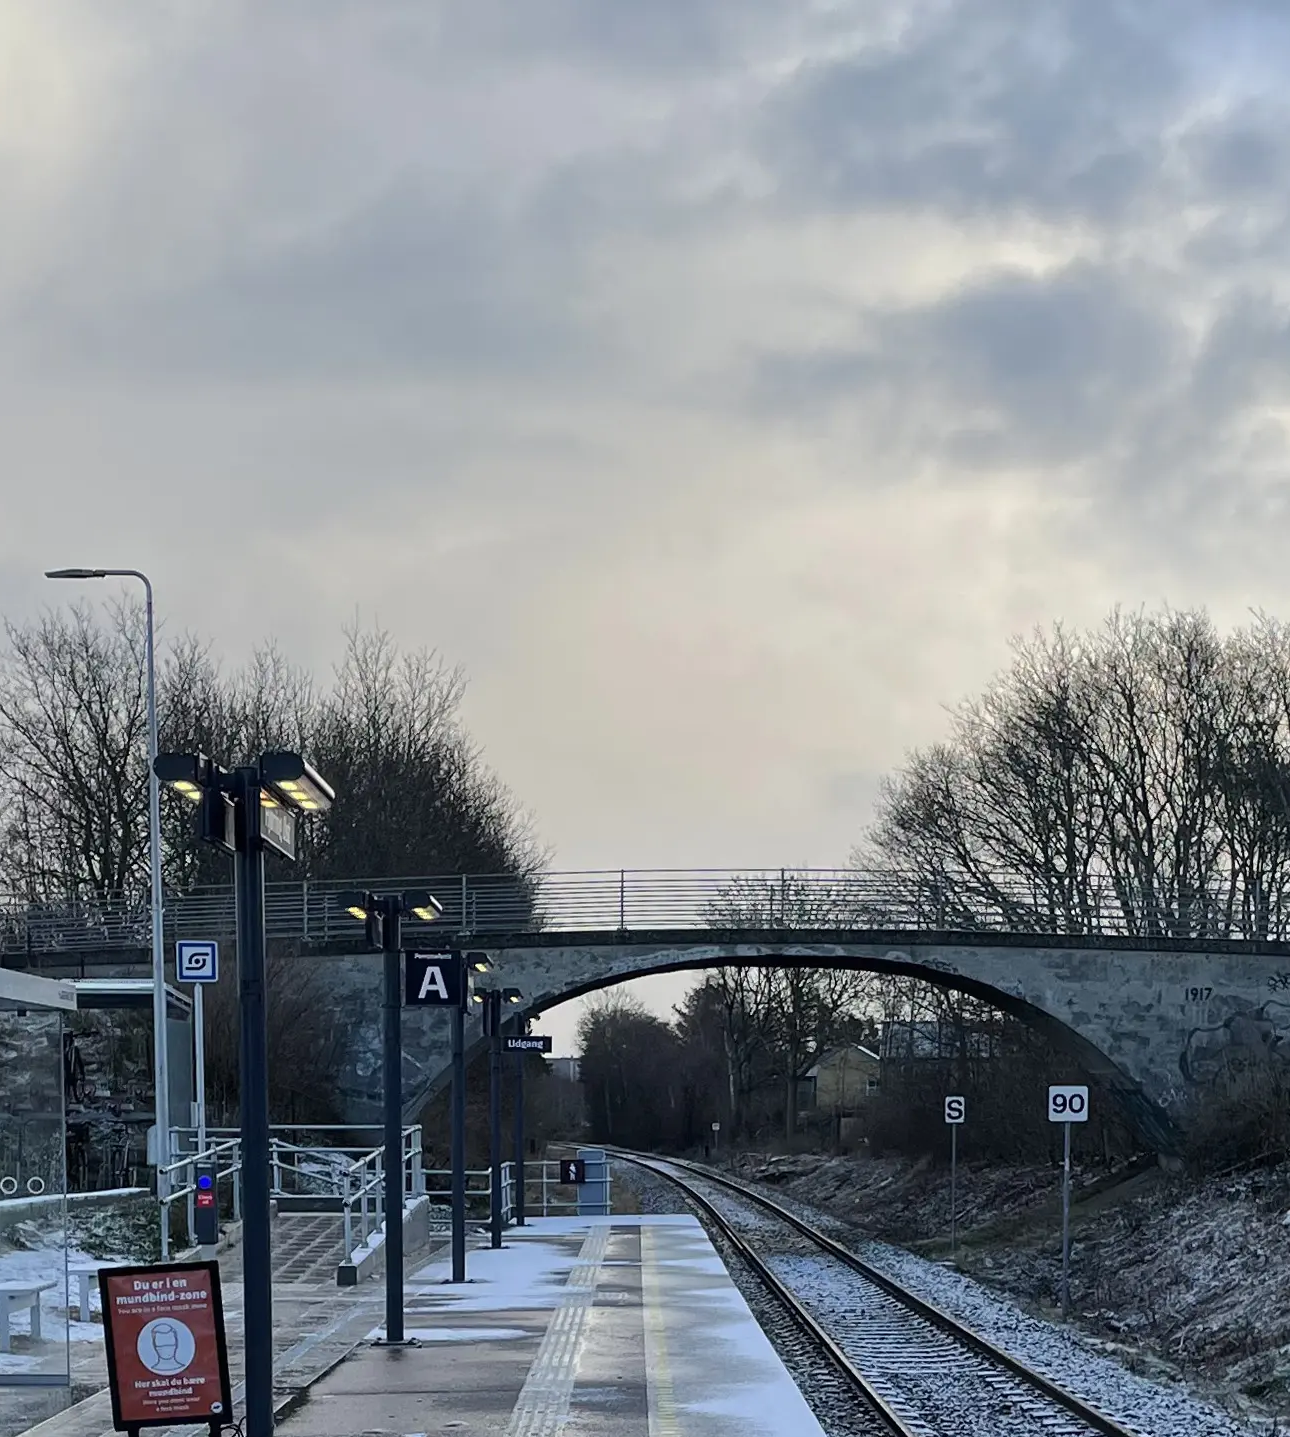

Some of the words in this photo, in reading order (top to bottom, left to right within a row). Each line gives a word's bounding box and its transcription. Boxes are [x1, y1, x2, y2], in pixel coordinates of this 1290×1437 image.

[418, 966, 449, 999] A
[1185, 987, 1213, 1001] 1917
[508, 1039, 544, 1049] Udgang
[947, 1099, 963, 1120] S
[1052, 1093, 1085, 1114] 90
[133, 1280, 149, 1291] Du
[151, 1279, 164, 1289] er
[172, 1278, 187, 1287] en
[116, 1290, 207, 1305] mundbind-zone
[170, 1377, 182, 1386] du
